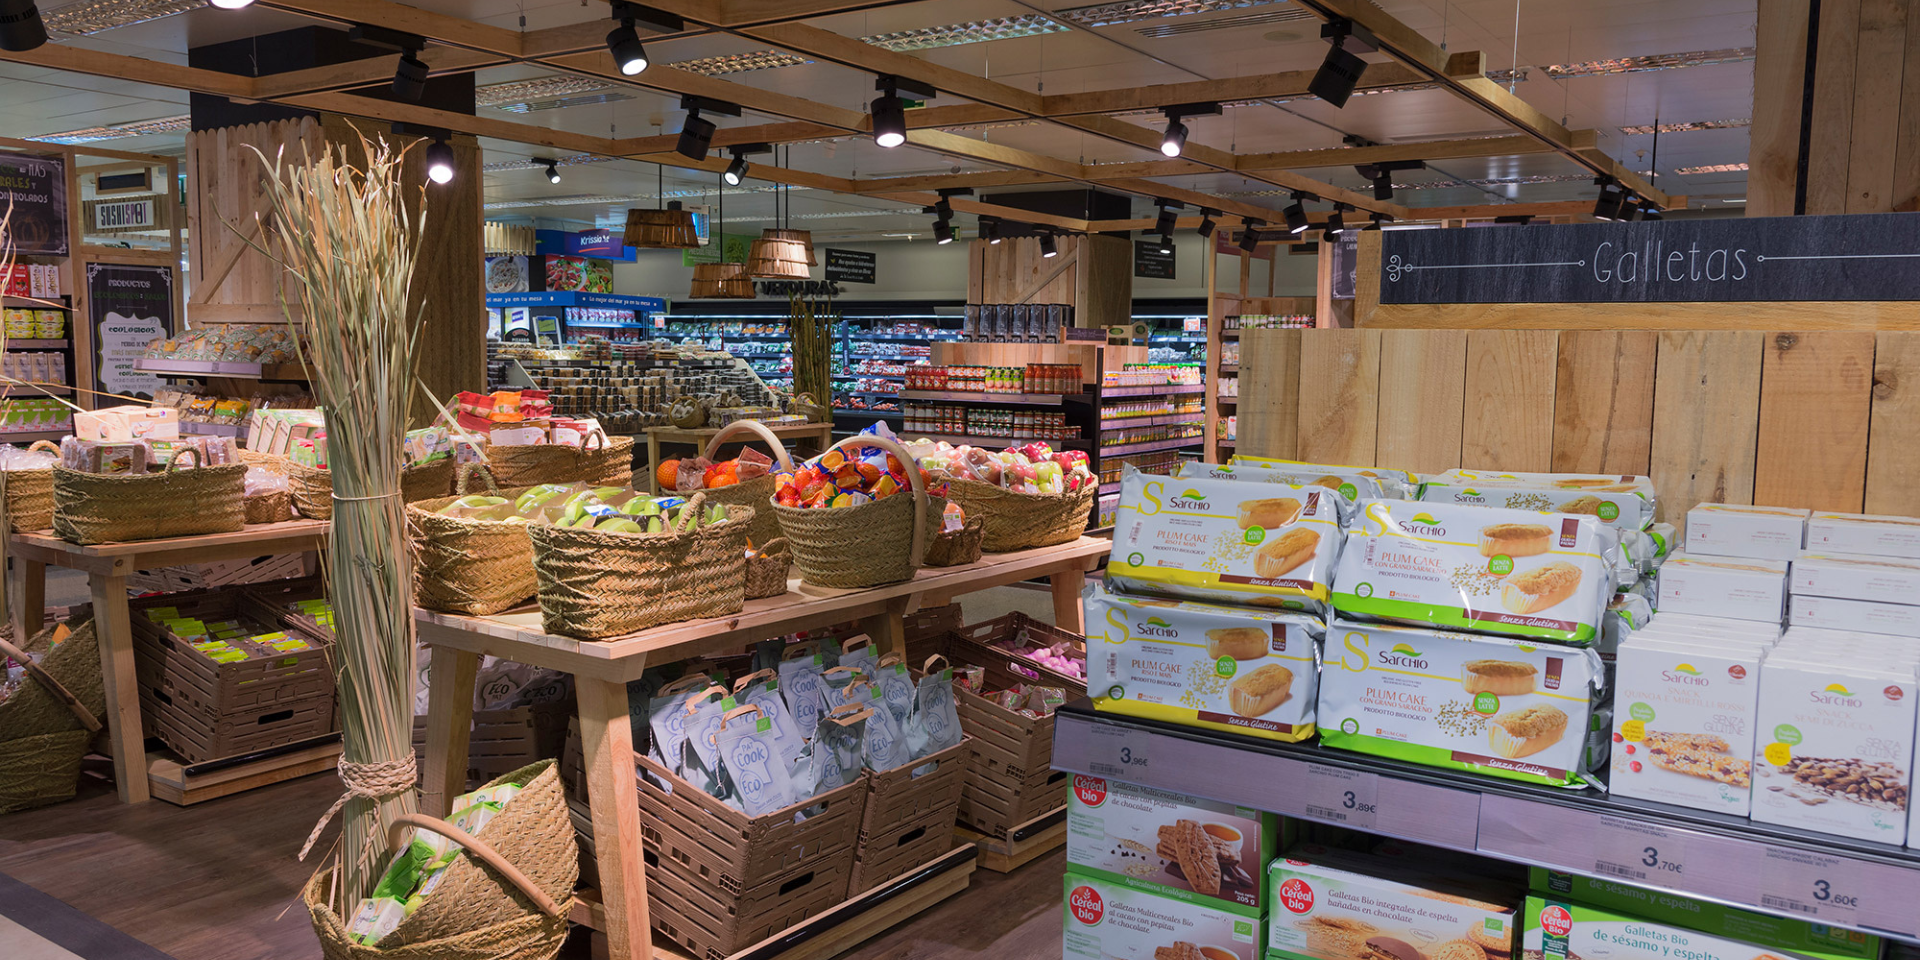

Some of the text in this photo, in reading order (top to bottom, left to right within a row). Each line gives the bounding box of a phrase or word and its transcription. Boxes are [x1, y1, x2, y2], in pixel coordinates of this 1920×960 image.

[1593, 241, 1748, 284] Galletas
[1137, 481, 1164, 516] S
[1157, 530, 1208, 544] PLUM CAKE
[1152, 545, 1206, 556] PRODOTTO BIOLOGICO
[1381, 551, 1442, 568] PLUM CAKE
[1378, 571, 1440, 583] PRODOTTO BIOLOGICO
[1388, 562, 1410, 571] GRANO
[1412, 565, 1447, 575] SARACENO
[1249, 577, 1299, 588] Senza Glutine
[1104, 607, 1130, 645] S
[1499, 615, 1560, 629] Senza Glutine
[1341, 631, 1369, 672] S
[1131, 659, 1182, 674] PLUM CAKE
[1130, 676, 1182, 688] PRODOTTO BIOLOGICO
[1366, 687, 1428, 705] PLUM CAKE
[1624, 689, 1662, 702] QUINOA
[1672, 695, 1715, 709] MIRTILLI
[1716, 701, 1745, 712] ROSSI
[1667, 687, 1701, 698] SNACK
[1359, 696, 1433, 714] CON GRANO SARACENO
[1817, 708, 1852, 719] SNACK
[1363, 707, 1427, 722] PRODOTTO BIOLOGICO
[1712, 714, 1744, 726] SENZA
[1795, 714, 1875, 732] SEMI DI ZUCCA
[1228, 717, 1278, 731] Senza Glutine
[1703, 722, 1745, 736] GLUTINE
[1855, 745, 1902, 760] GLUTINE
[1865, 737, 1902, 751] SENZA
[1120, 747, 1148, 766] 3,96€
[1488, 758, 1549, 776] Senza Glutine
[1081, 789, 1097, 803] bio
[1112, 781, 1196, 805] Galletas Multicereales Bio
[1120, 792, 1139, 802] cacao
[1140, 796, 1153, 804] con
[1153, 797, 1178, 810] pepitas
[1111, 798, 1153, 813] de chocolate
[1342, 791, 1376, 813] 3,89€
[1642, 846, 1682, 873] 3,70€
[1125, 877, 1161, 892] Agricultura
[1813, 879, 1858, 907] 3,60€
[1071, 894, 1102, 912] Céréal
[1236, 894, 1249, 904] 205
[1281, 886, 1312, 903] Céréal
[1589, 878, 1603, 889] de
[1606, 881, 1647, 901] sésamo
[1649, 893, 1657, 905] y
[1659, 895, 1701, 913] espelta
[1288, 899, 1304, 910] bio
[1327, 898, 1413, 923] bañadas en chocolate
[1328, 889, 1458, 924] Galletas Bio integrales de espelta
[1078, 908, 1094, 920] bio
[1109, 900, 1136, 913] Galletas
[1137, 906, 1181, 924] Multicereales
[1182, 917, 1194, 927] Bio
[1109, 909, 1175, 931] al cacao con pepitas
[1117, 919, 1150, 934] chocolate
[1624, 924, 1689, 946] Galletas Bio
[1593, 928, 1720, 960] de sésamo y espelta
